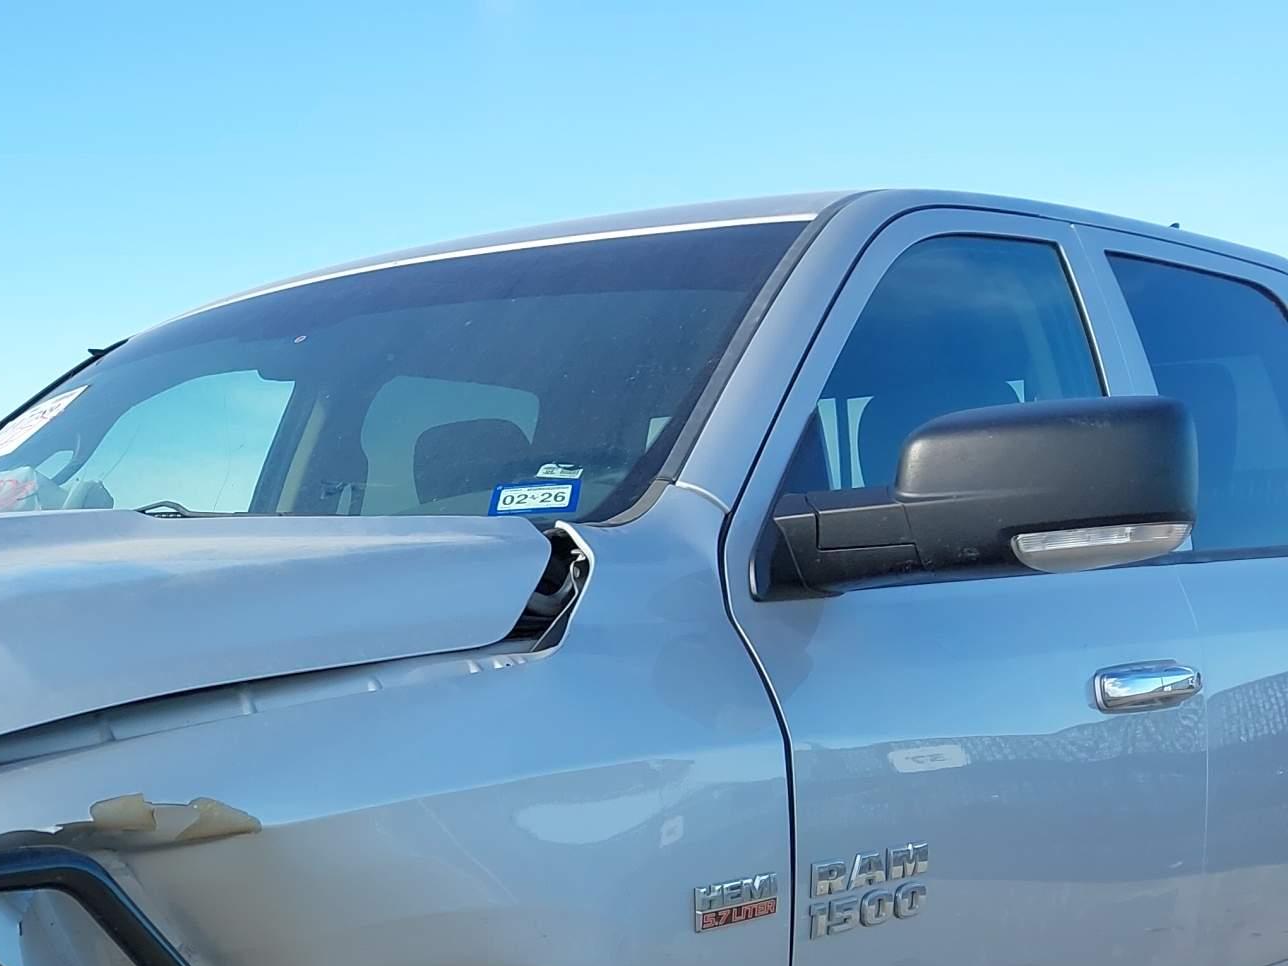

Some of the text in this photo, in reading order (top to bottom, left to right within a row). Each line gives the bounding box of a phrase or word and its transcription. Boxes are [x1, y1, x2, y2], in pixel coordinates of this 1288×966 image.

[501, 491, 566, 506] 02 26
[810, 842, 929, 898] RAM
[694, 872, 778, 912] HEMI
[809, 881, 927, 940] 1500
[702, 899, 776, 929] 5.7 LITER
